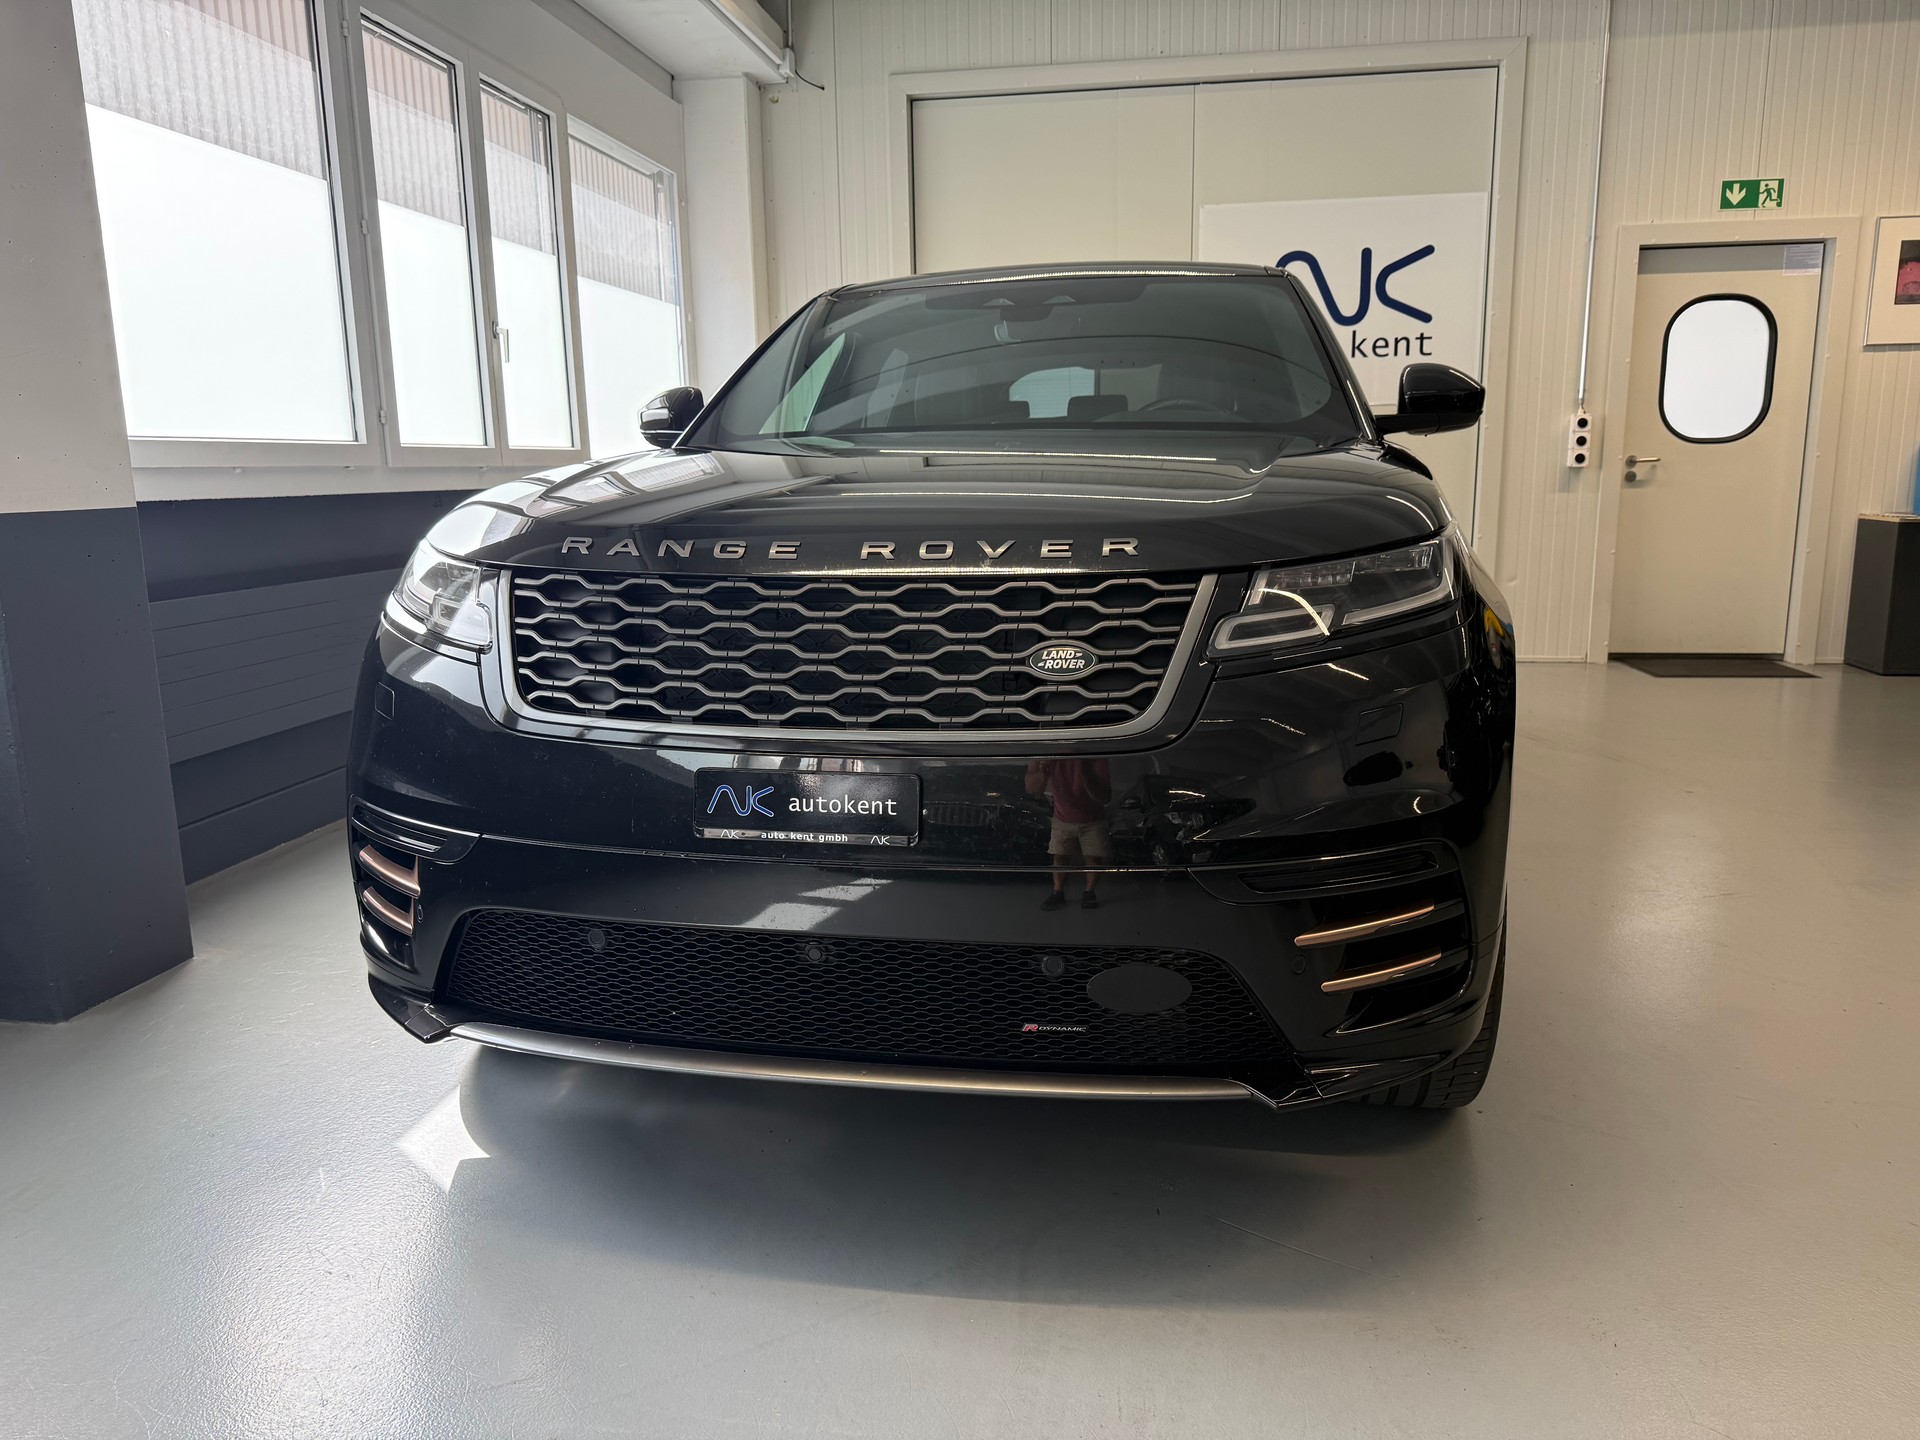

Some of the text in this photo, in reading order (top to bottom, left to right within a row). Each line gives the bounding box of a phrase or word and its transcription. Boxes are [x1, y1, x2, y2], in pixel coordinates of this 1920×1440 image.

[1350, 330, 1433, 359] kent
[561, 536, 1139, 560] RANGE ROVER
[1042, 650, 1075, 660] LAND
[1044, 659, 1086, 670] ROVER
[788, 795, 898, 816] autokent
[760, 831, 785, 840] auto
[790, 831, 815, 842] kent
[818, 833, 849, 842] gmbh
